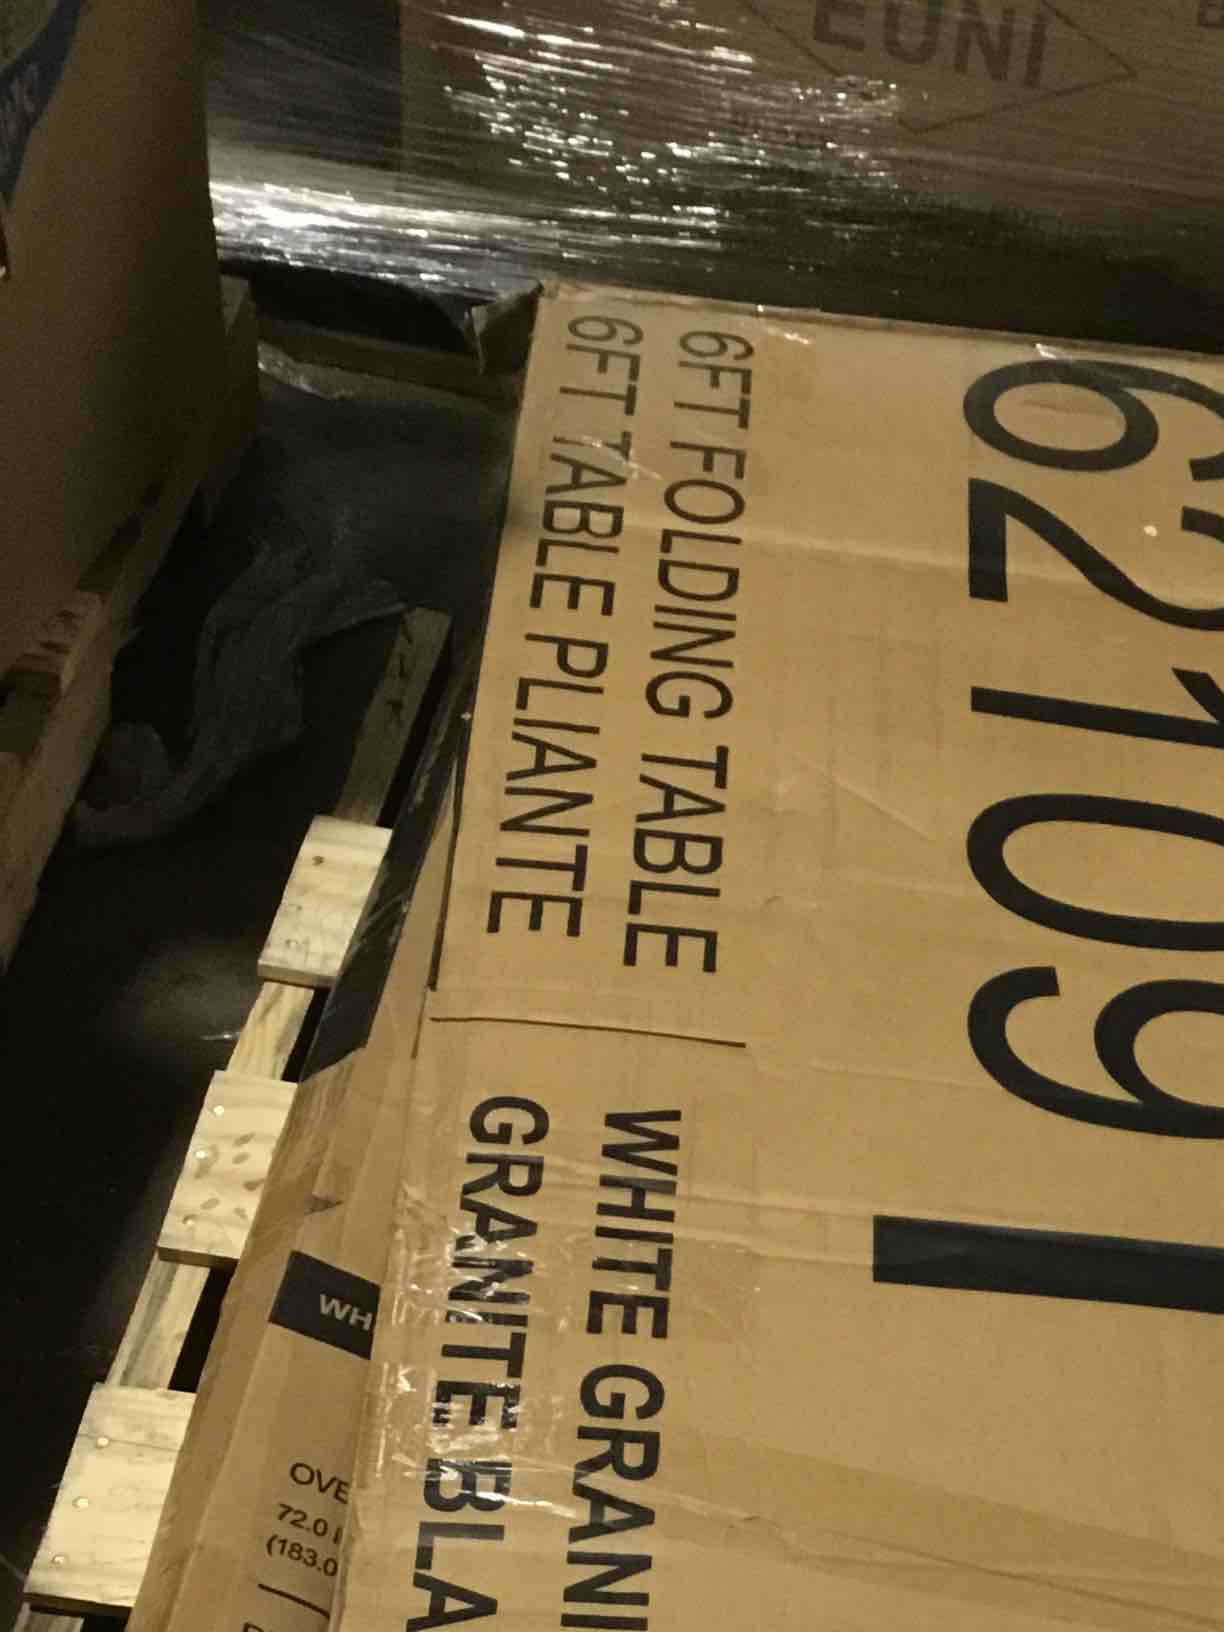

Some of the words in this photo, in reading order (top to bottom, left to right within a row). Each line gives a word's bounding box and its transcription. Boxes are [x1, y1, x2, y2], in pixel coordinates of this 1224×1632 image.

[559, 314, 643, 416] 6FT
[673, 329, 755, 430] 6FT
[529, 431, 633, 616] TABLE
[645, 440, 747, 720] FOLDING
[486, 632, 609, 938] PLIANTE
[623, 745, 729, 974] TABLE
[432, 1095, 550, 1430] GRANITE
[585, 1108, 682, 1340] WHITE
[320, 1293, 374, 1332] WH
[276, 1502, 328, 1538] 72.0
[289, 1462, 350, 1505] OVE
[265, 1534, 339, 1577] (183.0
